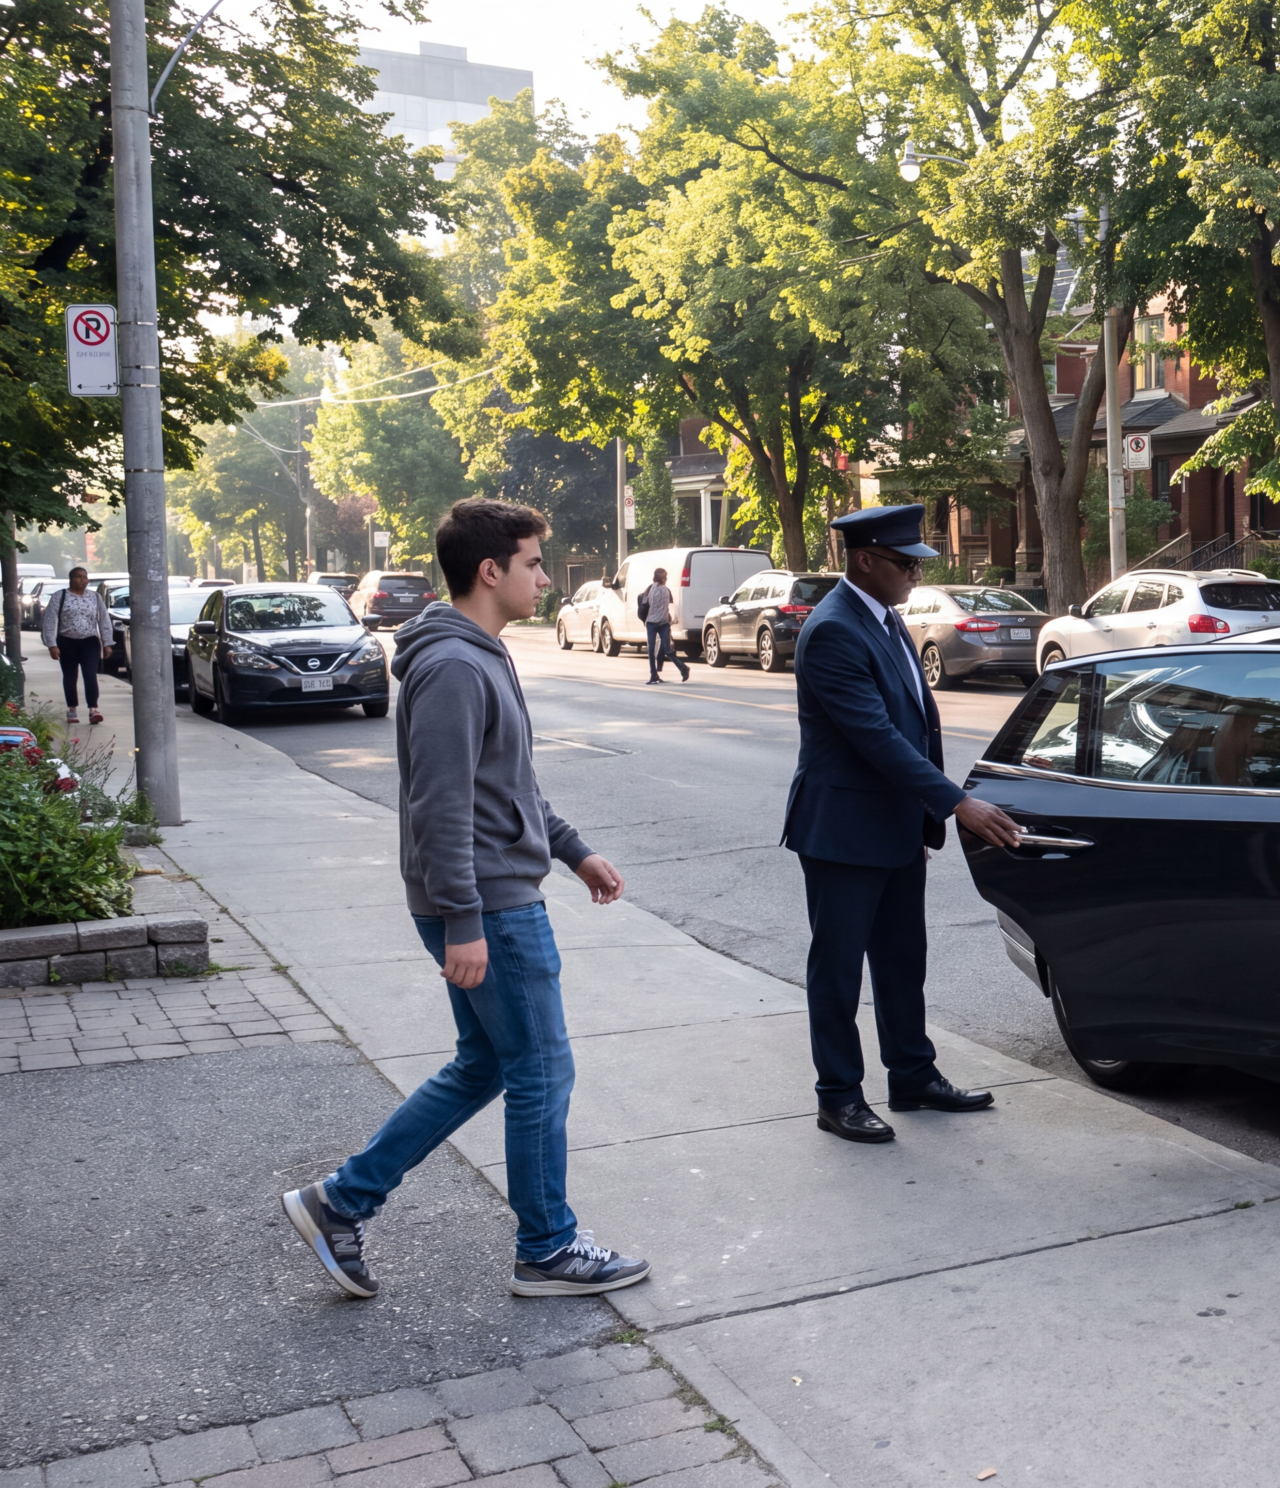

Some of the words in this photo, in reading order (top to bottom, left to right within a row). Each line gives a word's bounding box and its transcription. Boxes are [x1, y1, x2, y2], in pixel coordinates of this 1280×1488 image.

[85, 318, 101, 339] P
[331, 1233, 359, 1252] N
[563, 1257, 595, 1275] N
